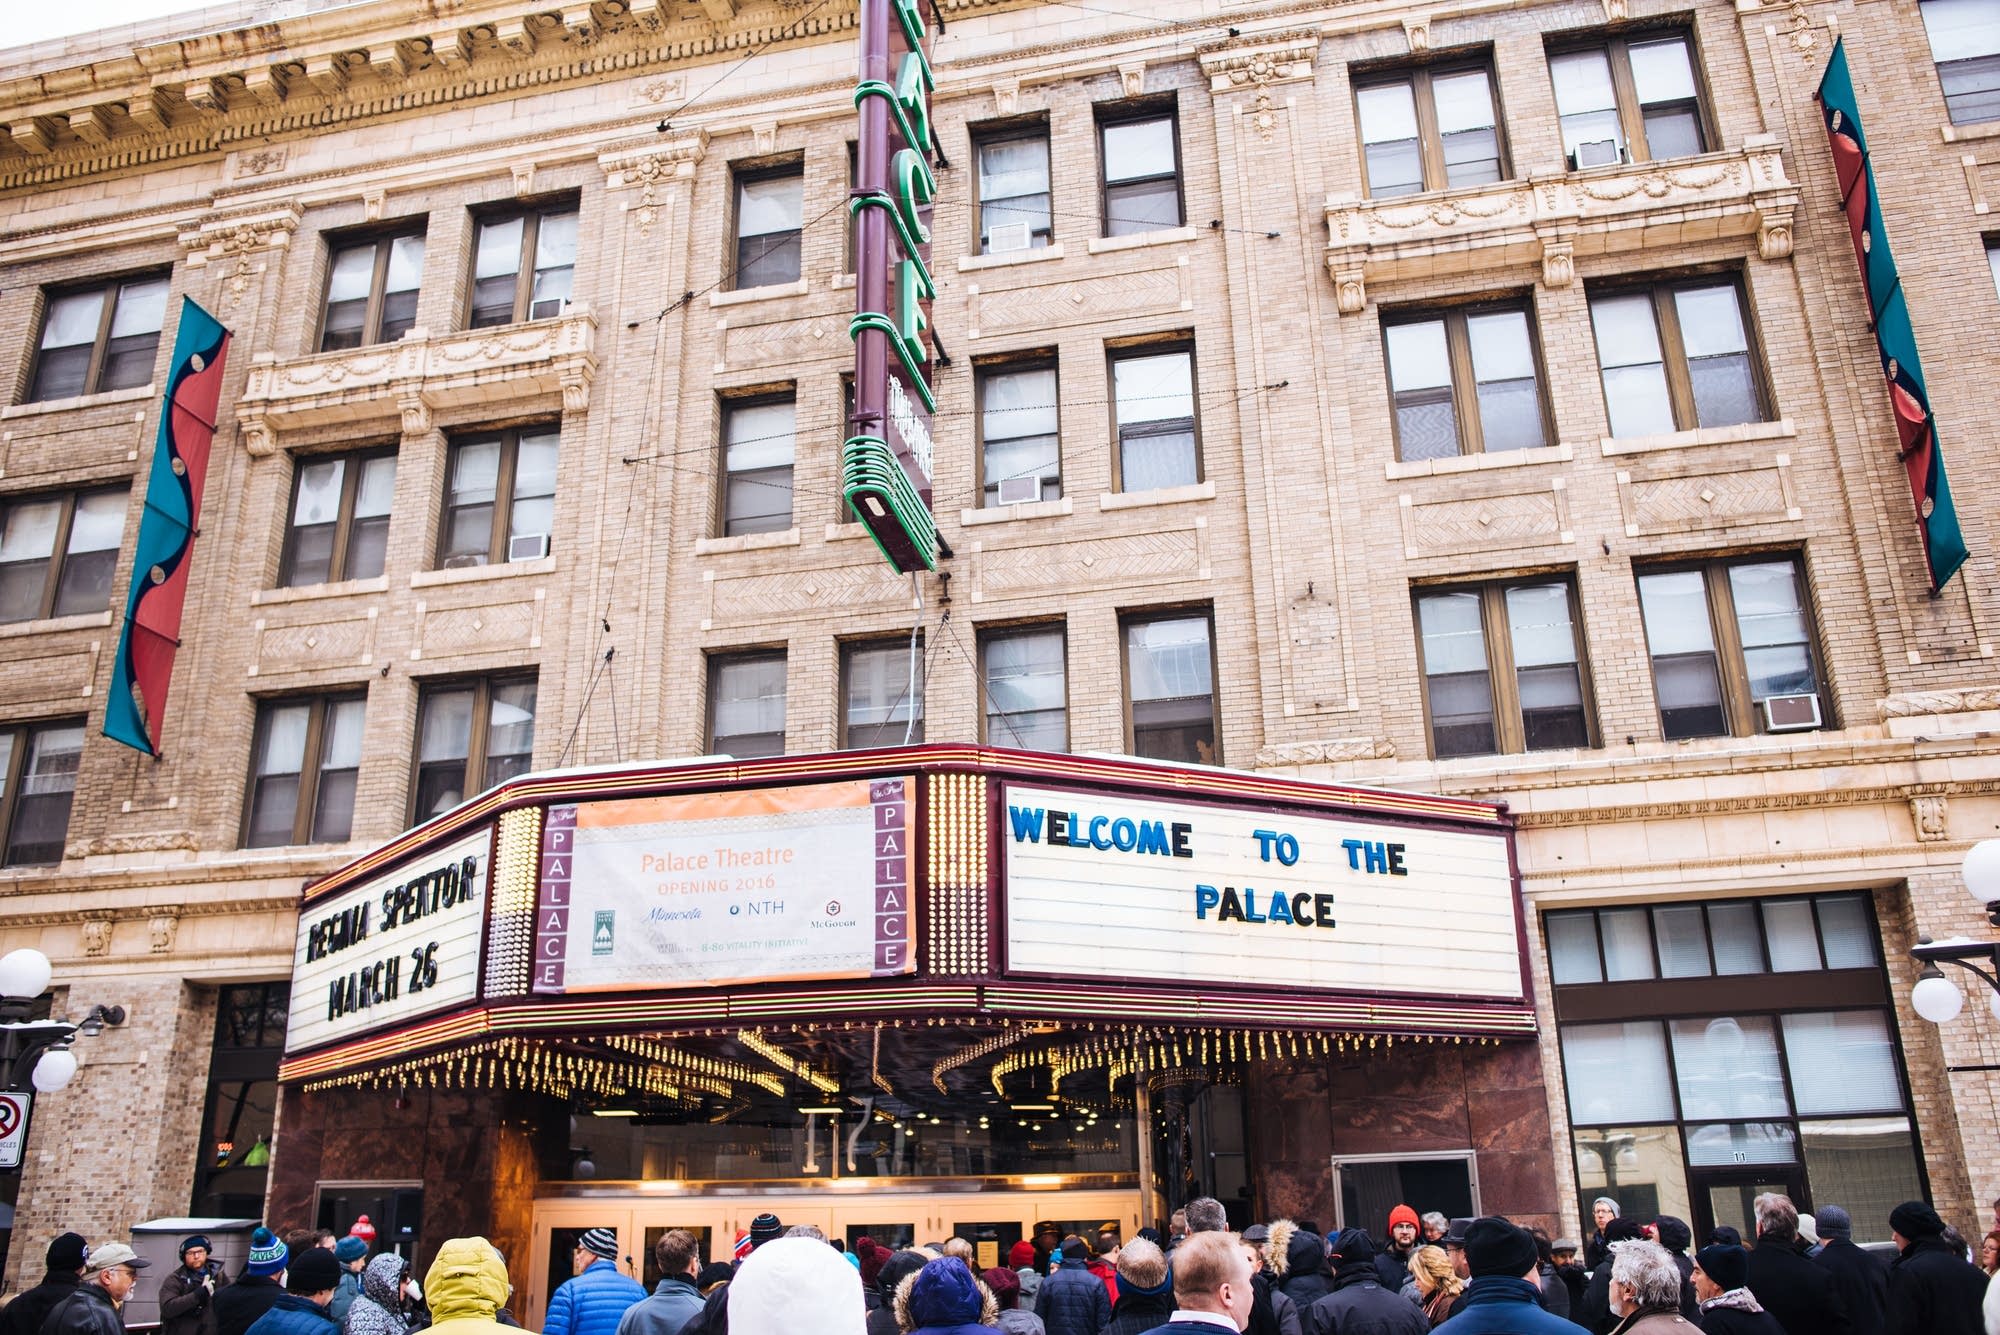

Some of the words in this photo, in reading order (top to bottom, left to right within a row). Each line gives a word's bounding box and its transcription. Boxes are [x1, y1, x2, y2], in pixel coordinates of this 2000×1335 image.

[1009, 806, 1193, 858] WELCOME
[1253, 829, 1300, 866] TO
[1341, 839, 1408, 876] THE
[642, 852, 709, 873] Palace
[715, 847, 795, 868] Theatre
[657, 879, 729, 896] OPENING
[735, 873, 776, 891] 2016
[883, 807, 900, 965] PALACE
[306, 900, 371, 964] REGINA
[380, 855, 477, 933] SPEKTOR
[544, 832, 566, 984] PALACE
[646, 905, 703, 924] Minnesota
[748, 901, 785, 916] NTH
[1196, 884, 1336, 929] PALACE
[726, 940, 761, 952] VITALITY
[764, 937, 809, 950] INITIATIVE
[328, 955, 401, 1021] MARCH
[409, 941, 439, 994] 26
[1733, 1151, 1747, 1162] 11
